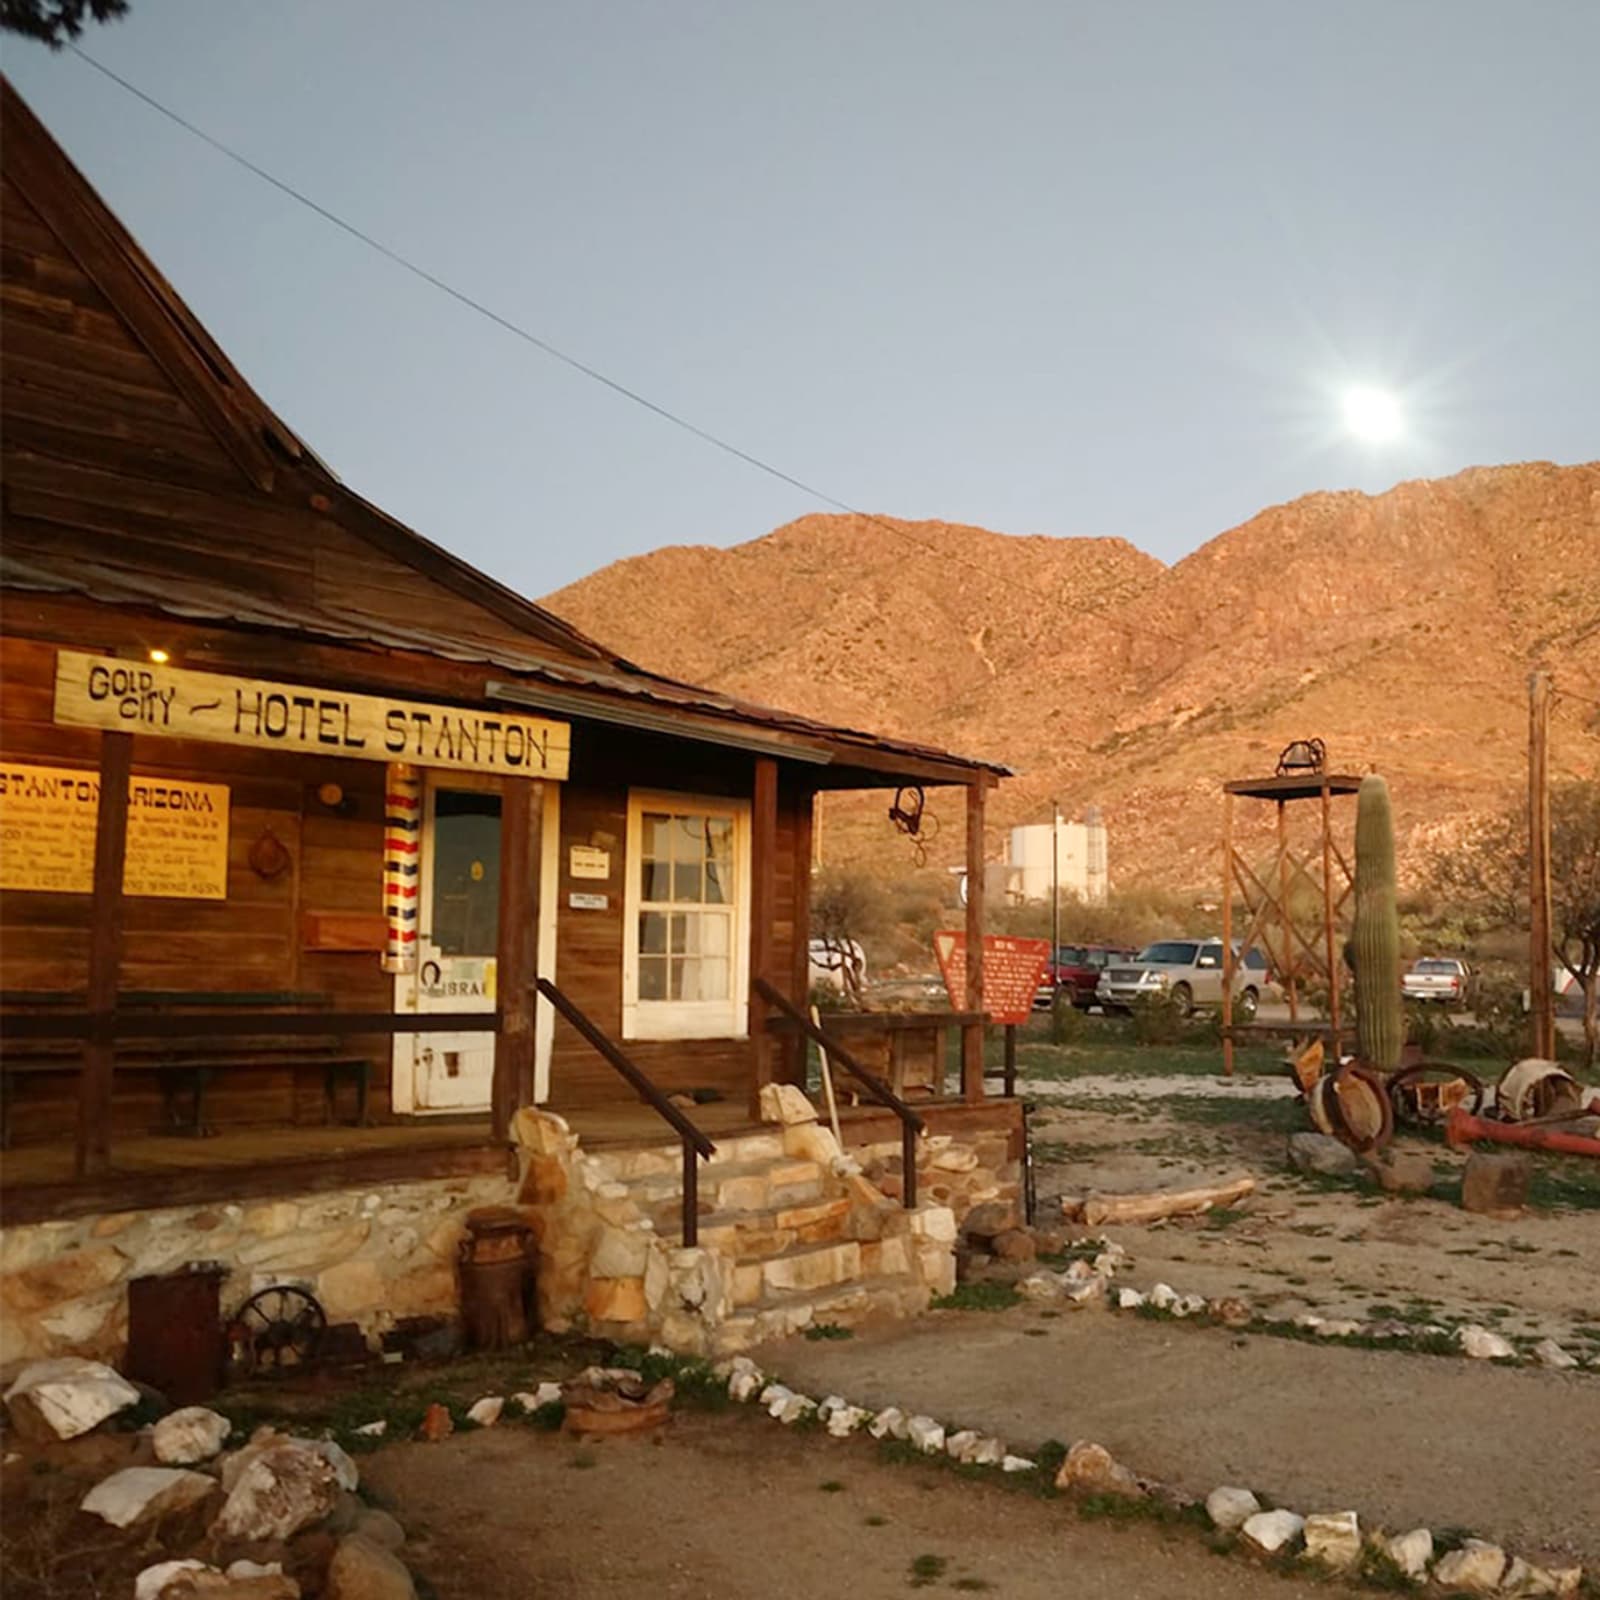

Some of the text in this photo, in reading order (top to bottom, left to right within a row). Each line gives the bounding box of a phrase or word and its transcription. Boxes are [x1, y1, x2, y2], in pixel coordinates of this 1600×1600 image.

[88, 666, 153, 700] GOLD
[119, 687, 176, 725] CITY
[234, 689, 366, 748] HOTEL
[385, 709, 548, 769] STANTON
[127, 787, 213, 813] RIZONA
